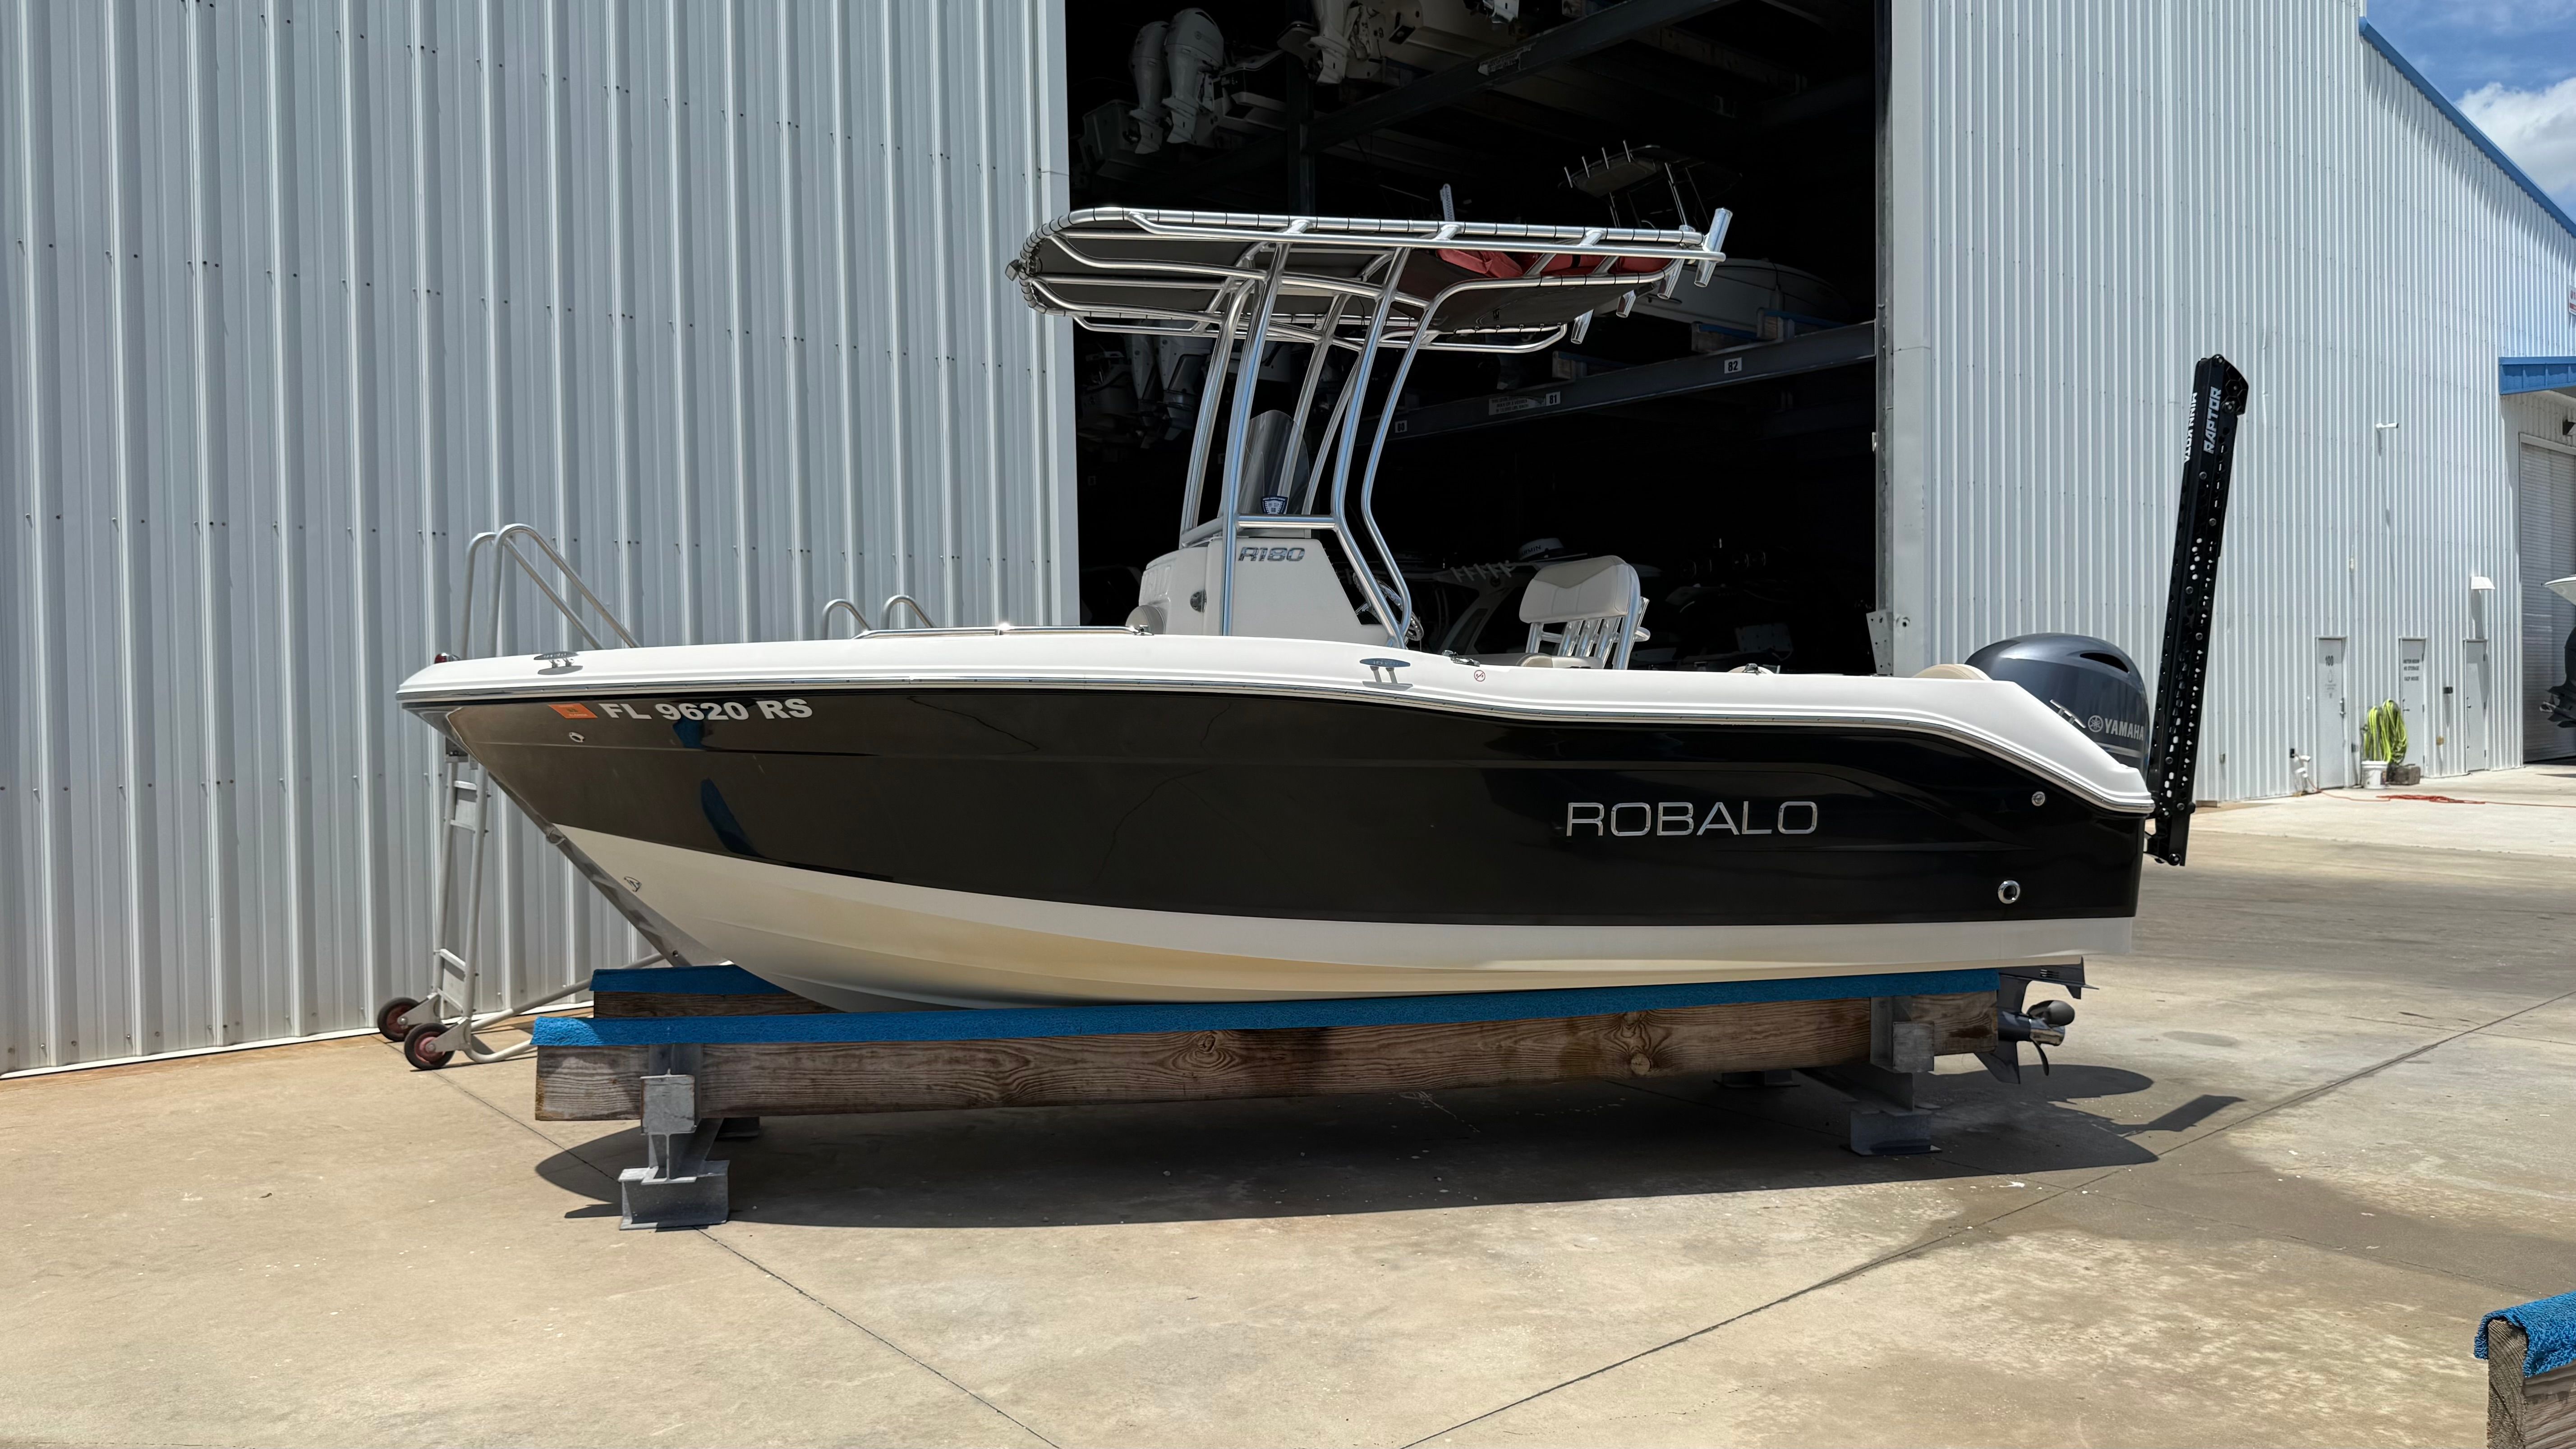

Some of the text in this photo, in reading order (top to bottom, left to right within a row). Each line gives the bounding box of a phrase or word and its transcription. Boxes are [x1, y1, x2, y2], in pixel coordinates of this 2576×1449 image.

[1728, 361, 1738, 371] 82
[1550, 394, 1557, 404] 81
[2184, 392, 2197, 463] MINN KOTA
[2203, 386, 2221, 454] RAPTOR
[1238, 547, 1305, 561] R180
[598, 699, 813, 720] FL 9620 RS
[2104, 718, 2144, 741] YAMAHA
[1566, 801, 1817, 836] ROBALO
